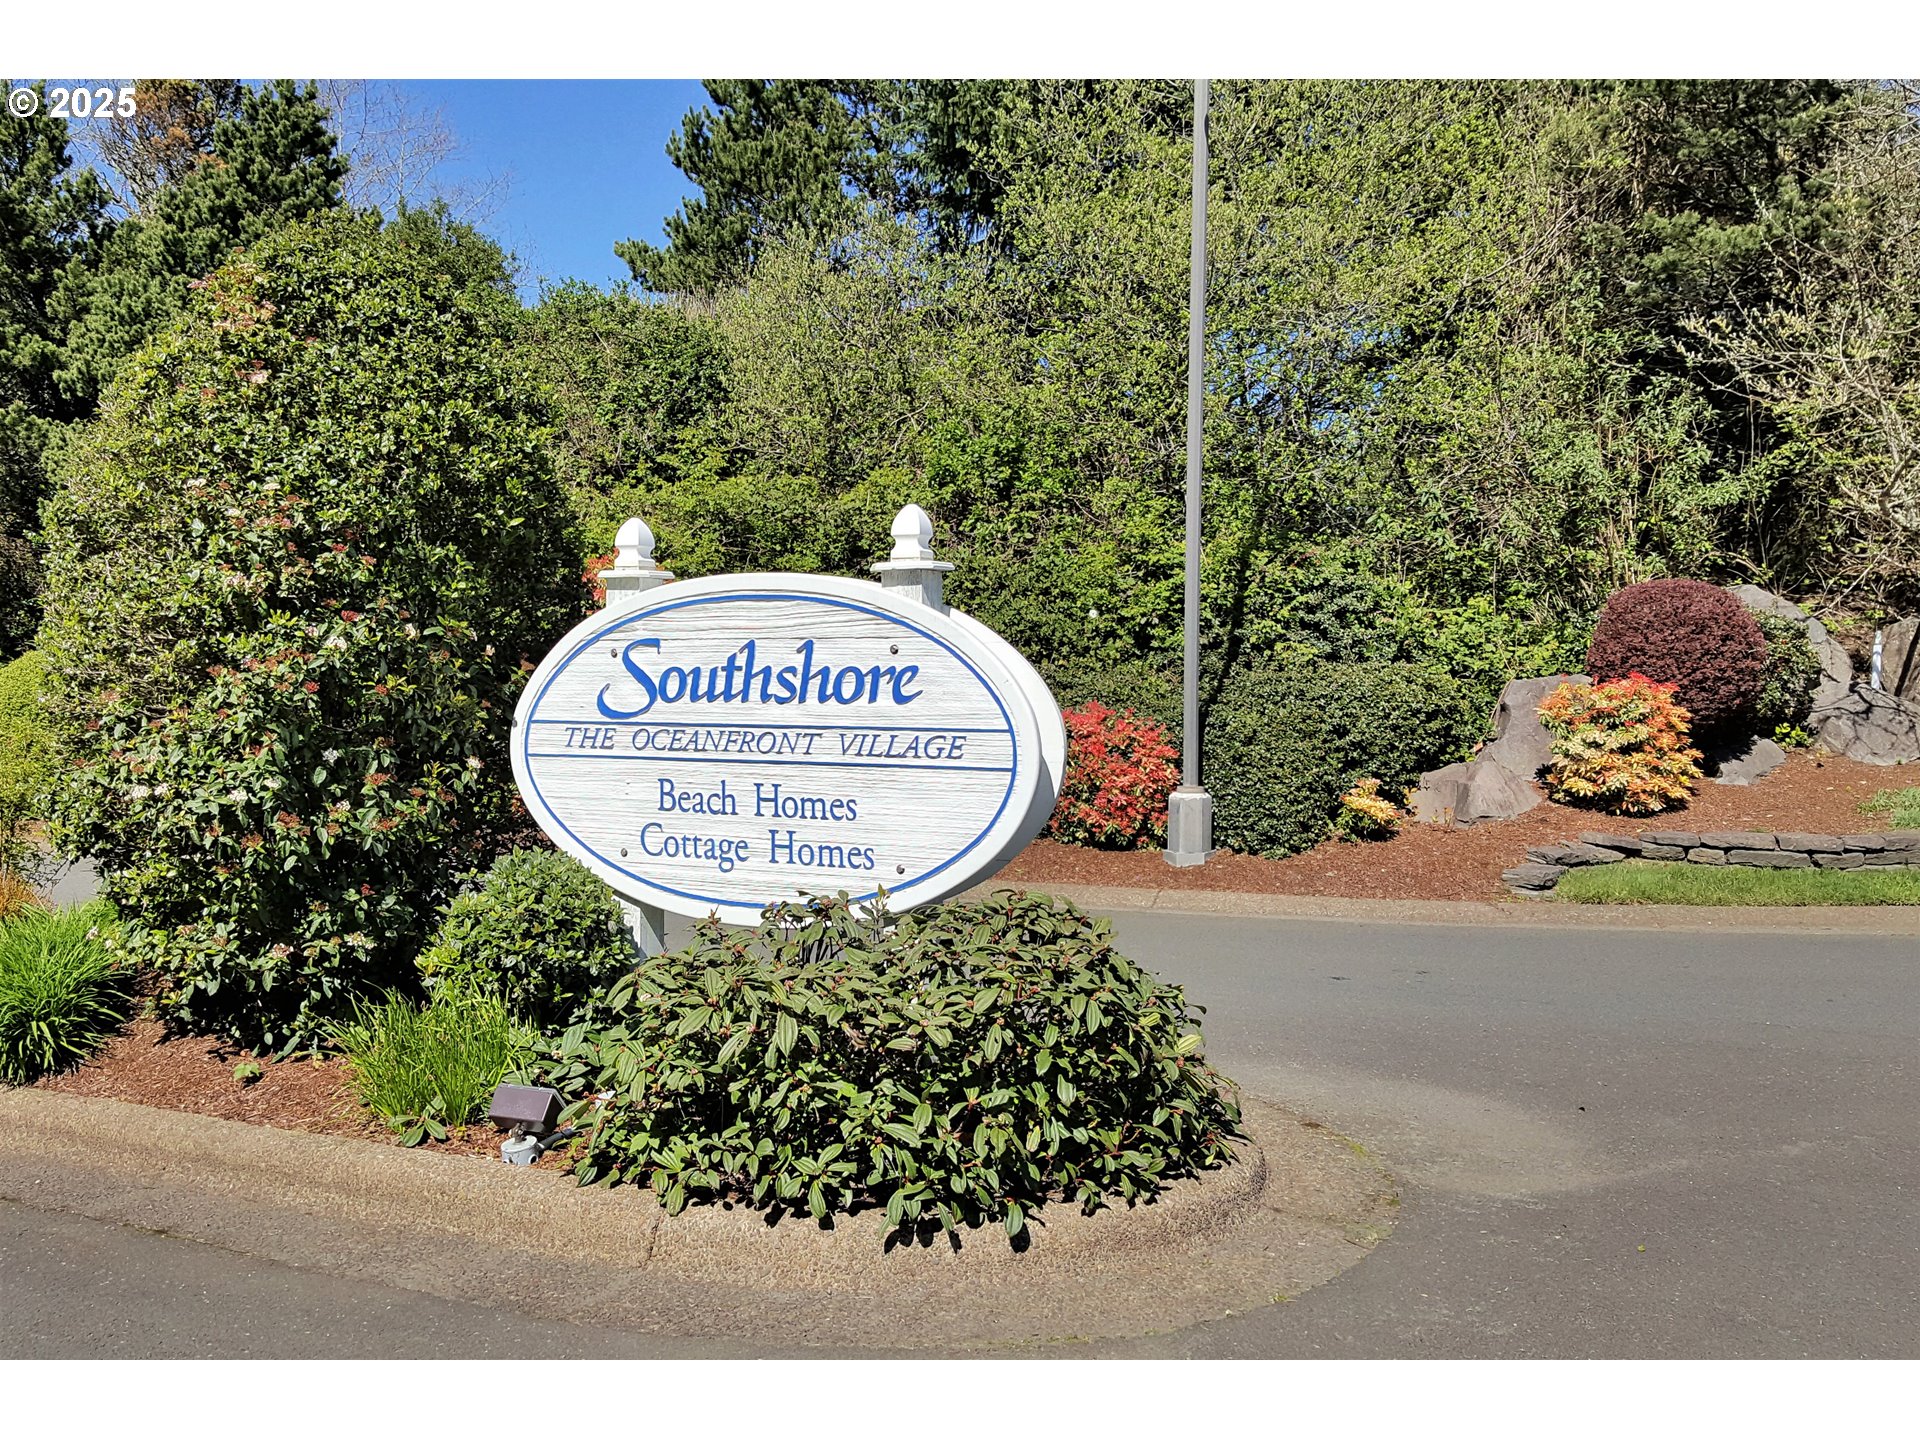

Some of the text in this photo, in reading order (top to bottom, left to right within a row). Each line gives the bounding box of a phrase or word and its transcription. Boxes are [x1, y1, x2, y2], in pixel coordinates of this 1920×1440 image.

[597, 638, 924, 720] Southshore
[565, 727, 967, 760] THE OCEANFRONT VILLAGE
[657, 778, 858, 822] Beach Homes
[640, 822, 876, 873] Cottage Homes
